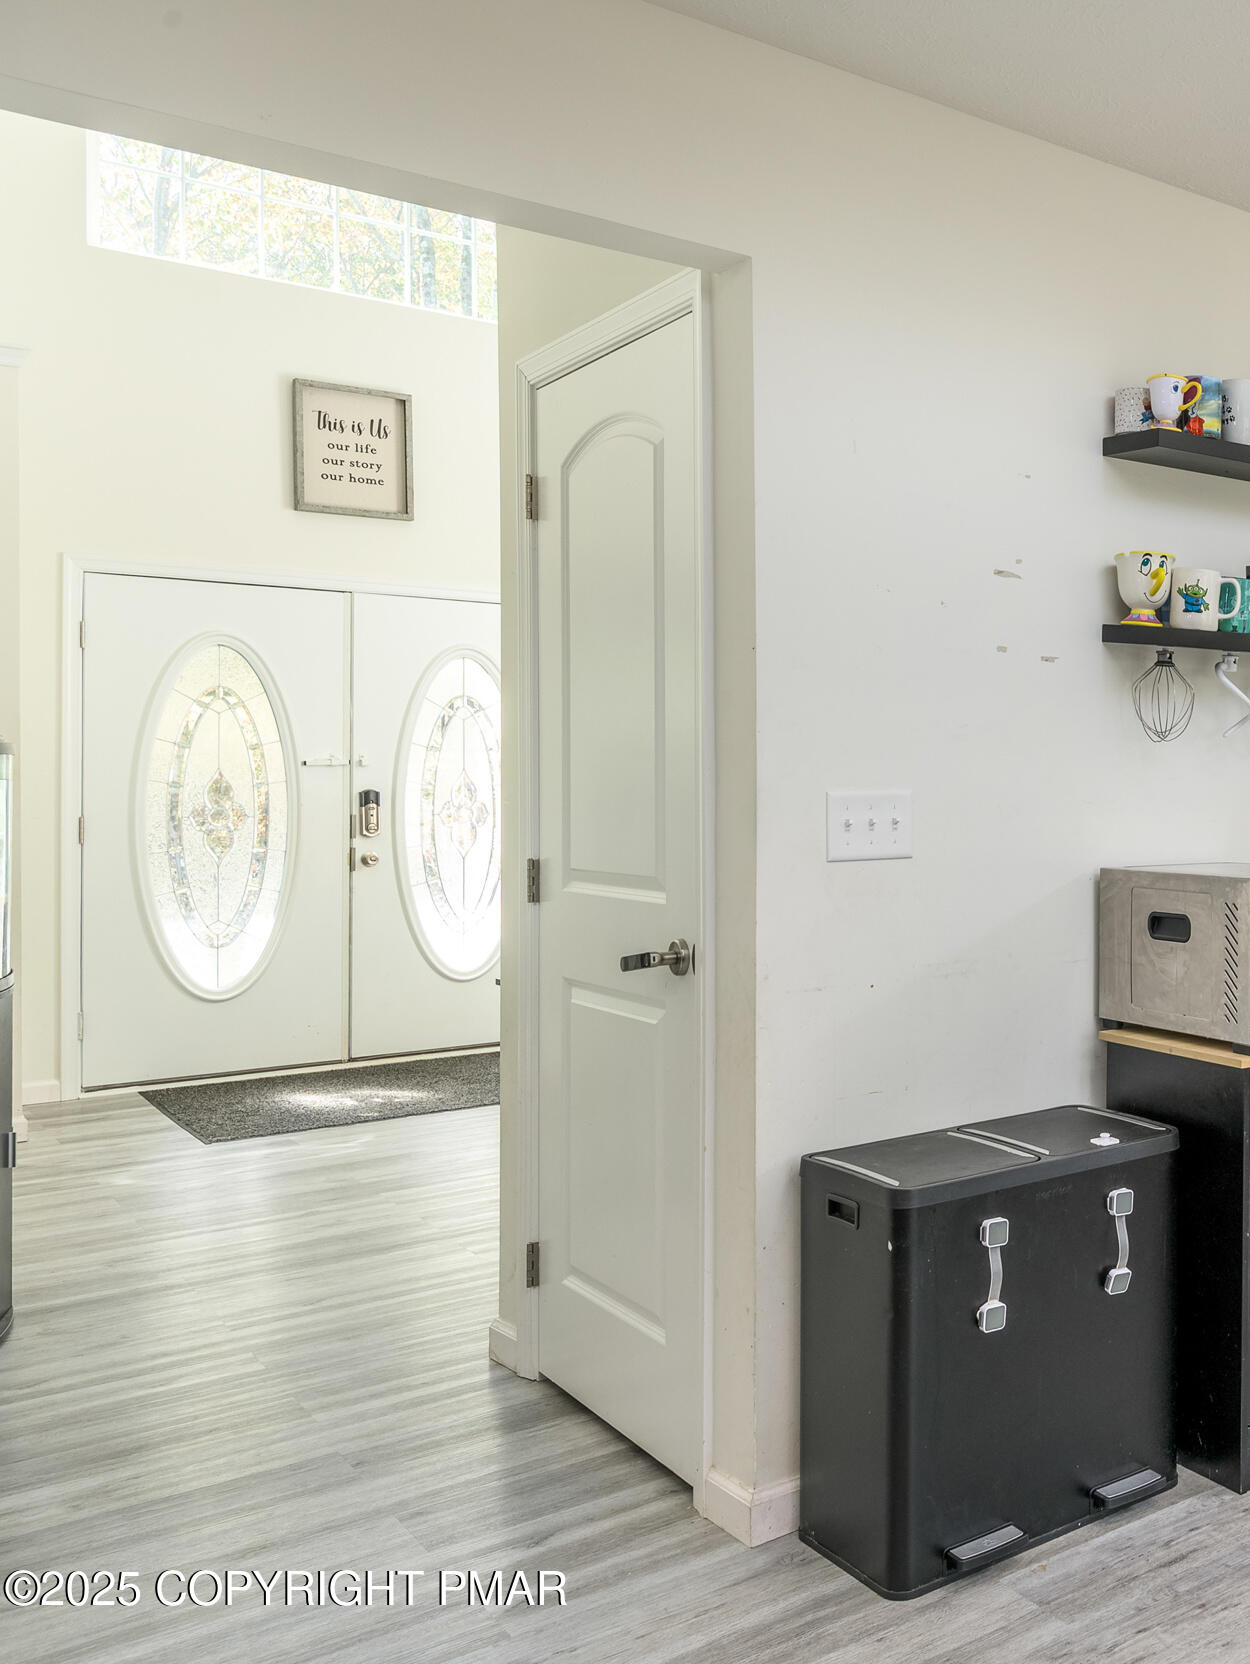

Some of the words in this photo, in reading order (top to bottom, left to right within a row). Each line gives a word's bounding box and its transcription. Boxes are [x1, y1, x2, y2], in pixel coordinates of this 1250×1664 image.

[312, 410, 347, 434] This
[351, 420, 365, 436] is
[369, 418, 391, 440] Us
[327, 442, 350, 452] our
[355, 443, 377, 455] life
[322, 457, 345, 467] our
[349, 459, 383, 473] story
[321, 472, 344, 482] our
[349, 473, 385, 486] home
